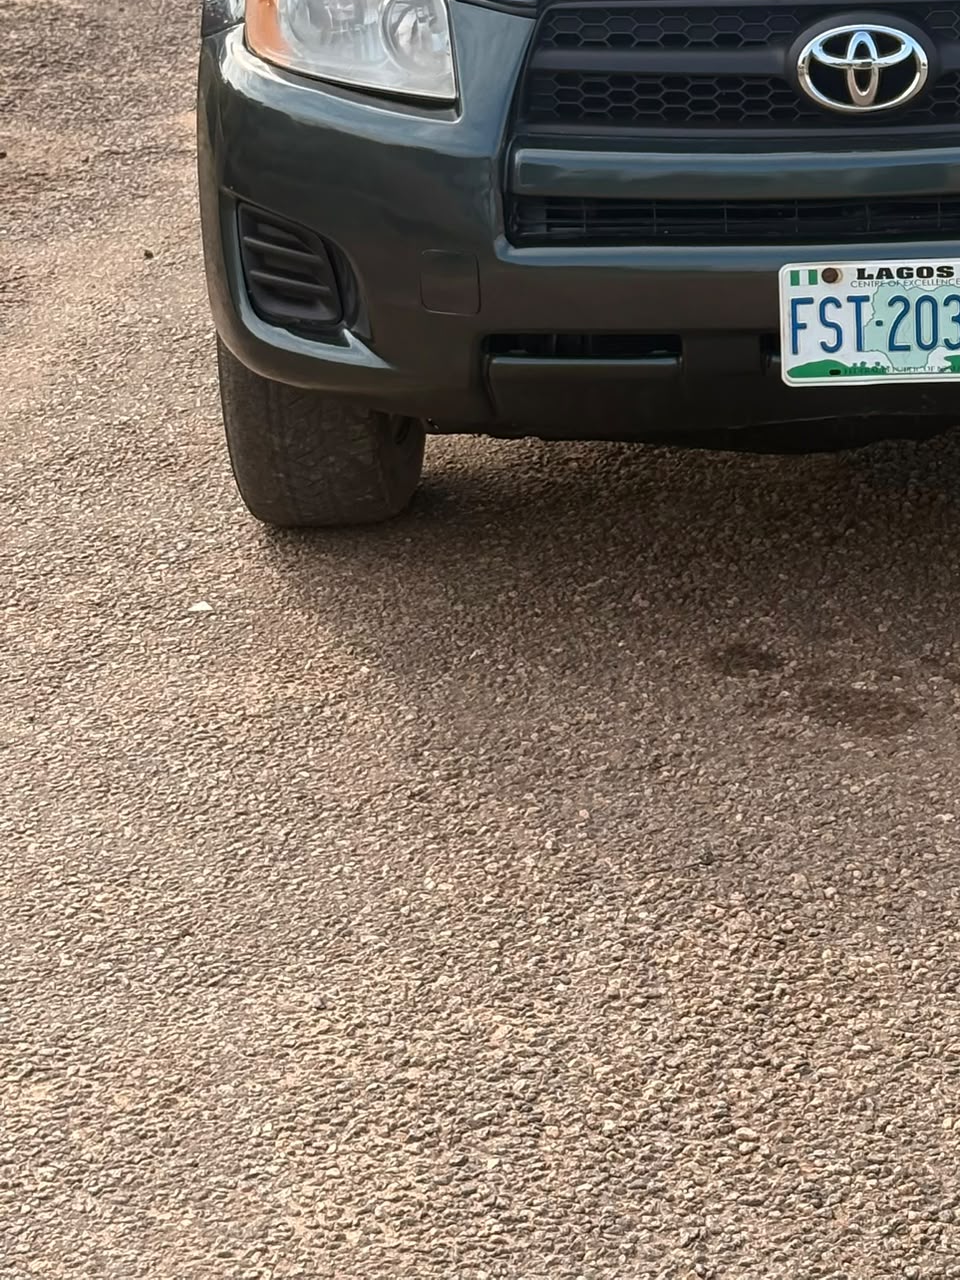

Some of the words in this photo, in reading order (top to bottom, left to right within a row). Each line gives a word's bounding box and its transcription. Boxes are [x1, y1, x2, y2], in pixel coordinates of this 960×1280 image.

[856, 266, 954, 280] LAGOS
[850, 280, 885, 288] CENTRE
[904, 278, 960, 287] EXCELLENCE
